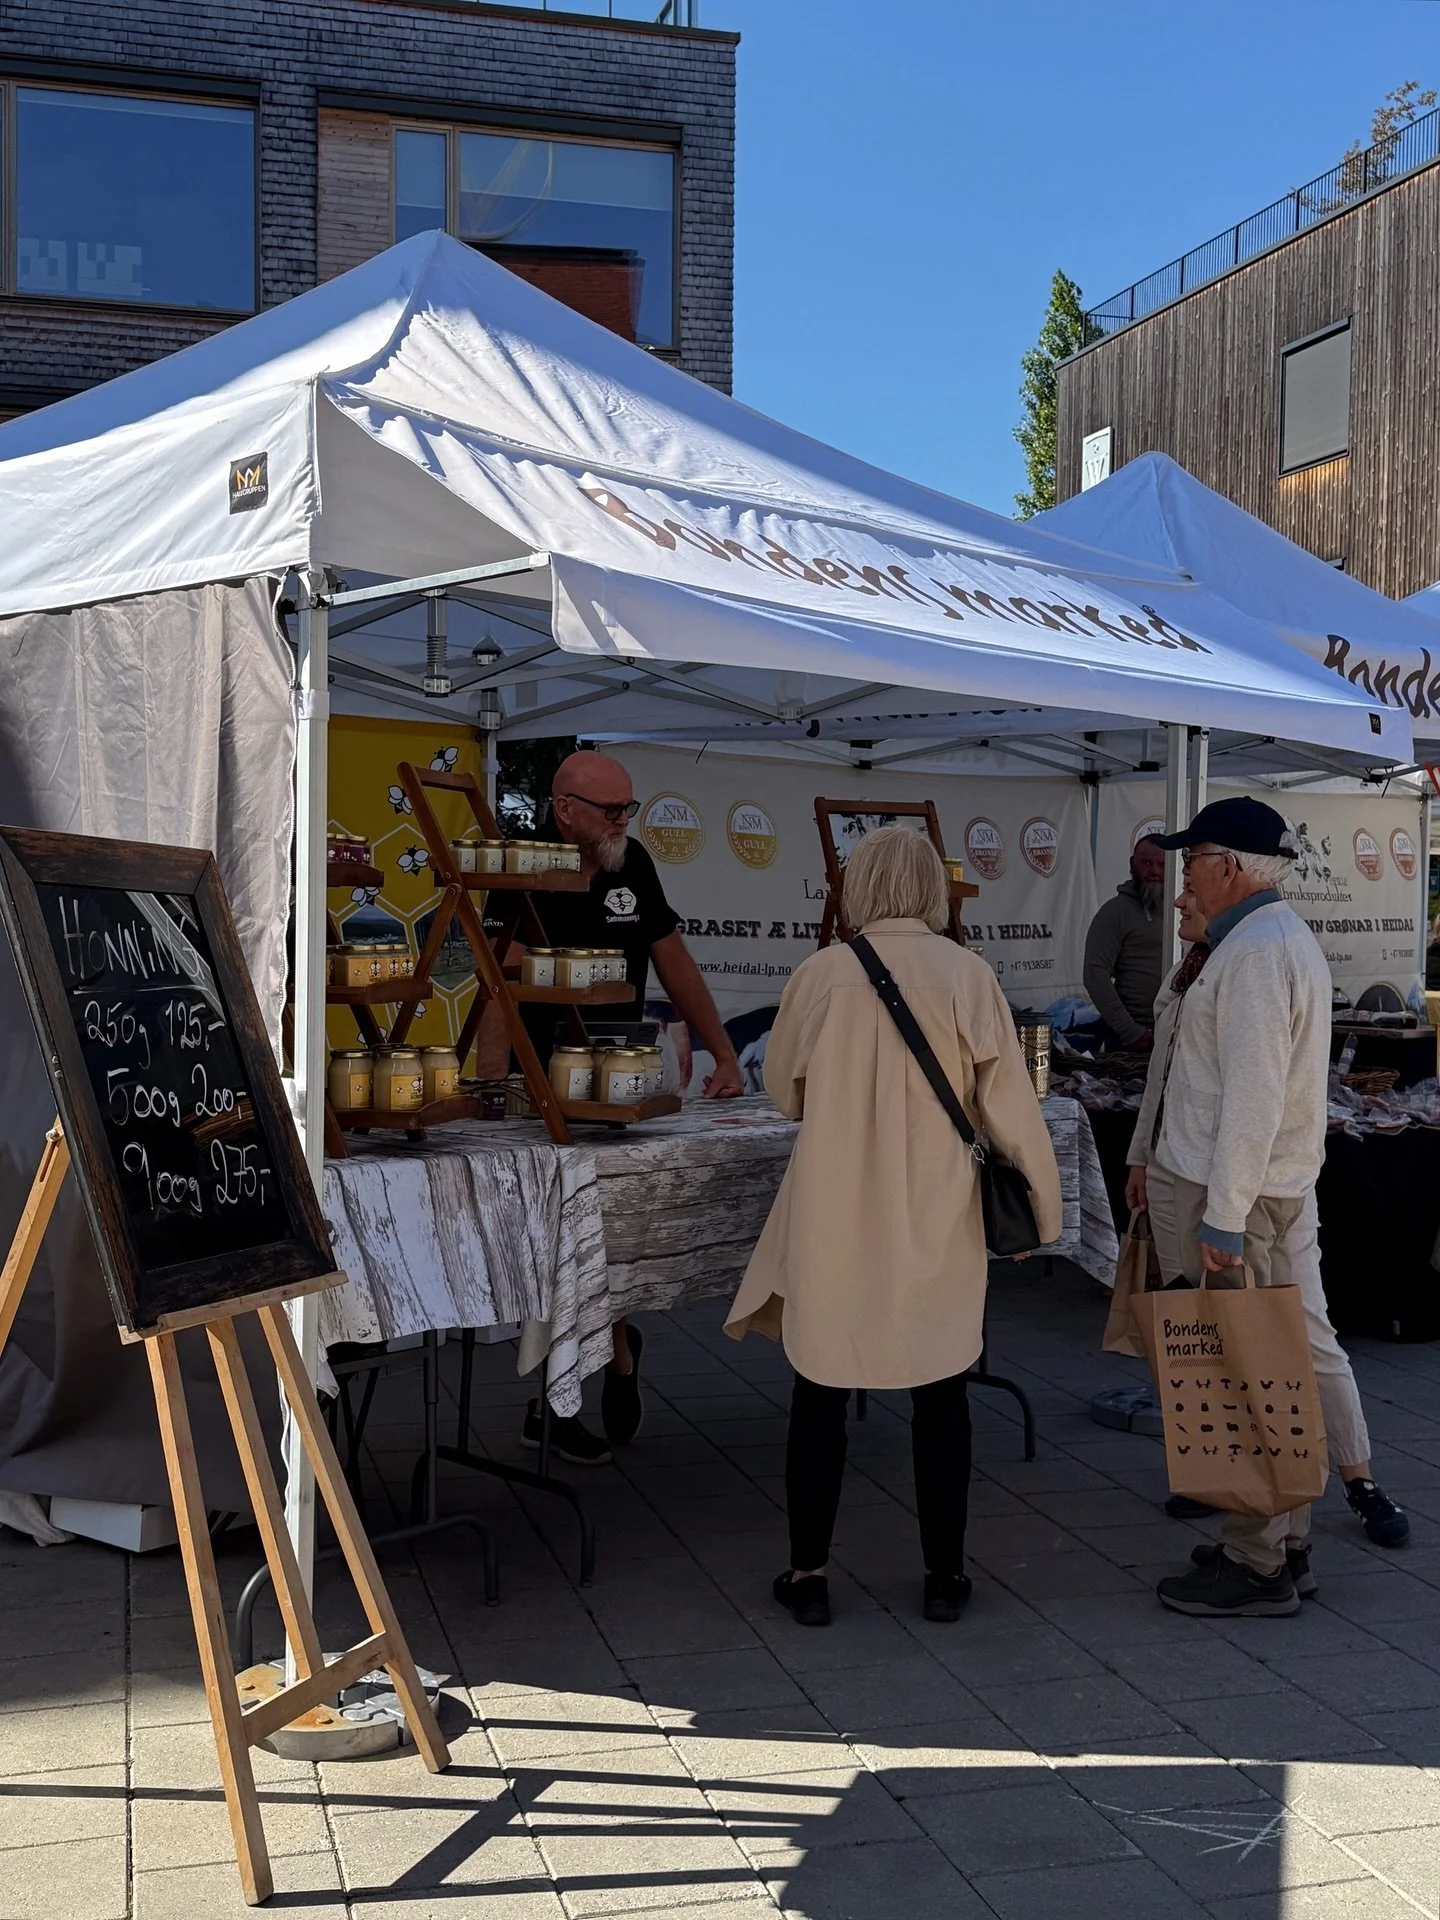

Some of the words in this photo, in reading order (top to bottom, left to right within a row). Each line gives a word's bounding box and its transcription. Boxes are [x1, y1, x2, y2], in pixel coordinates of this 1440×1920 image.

[661, 829, 687, 837] GULL
[743, 839, 766, 850] GULL
[767, 921, 787, 939] Æ
[998, 923, 1053, 941] HEIDAL
[1325, 918, 1373, 934] GRØNAR
[1382, 917, 1415, 933] HEIDAL
[84, 1000, 151, 1070] 250g
[107, 1067, 180, 1127] 500g
[123, 1141, 203, 1213] 900g
[1163, 1318, 1219, 1340] Bondens
[1166, 1337, 1224, 1356] marked
